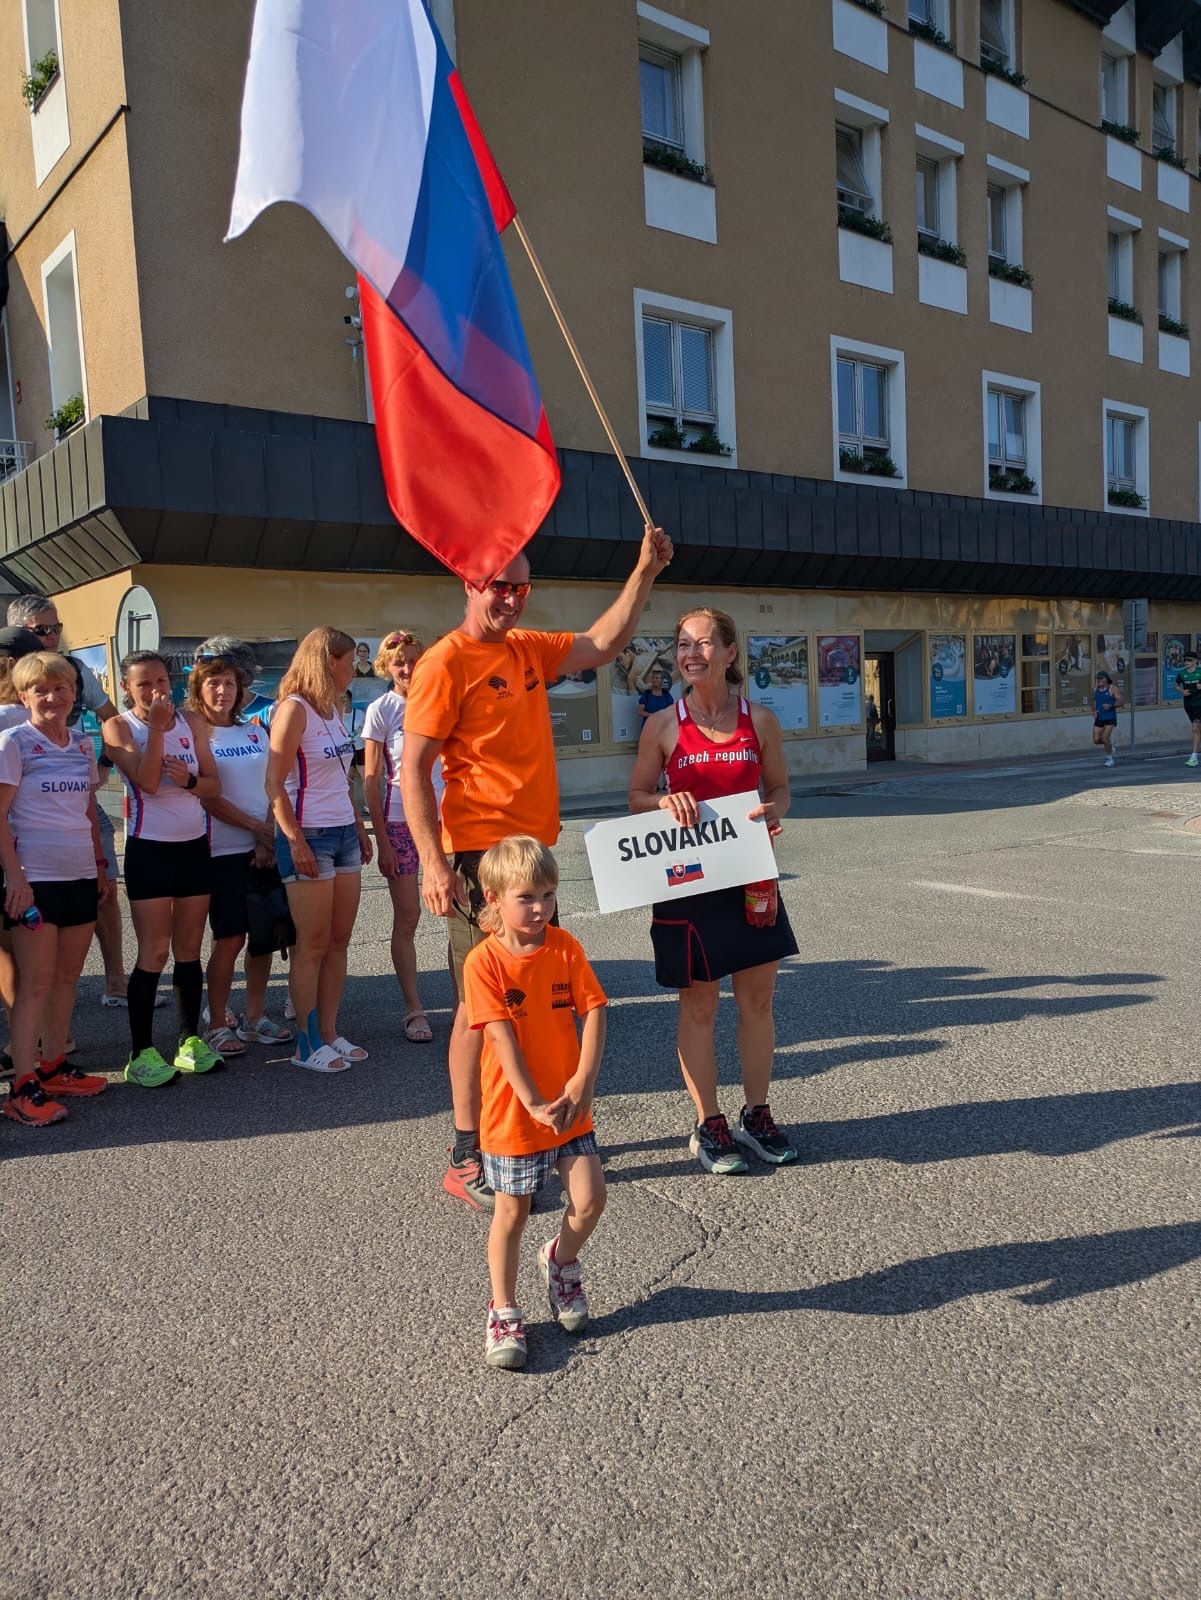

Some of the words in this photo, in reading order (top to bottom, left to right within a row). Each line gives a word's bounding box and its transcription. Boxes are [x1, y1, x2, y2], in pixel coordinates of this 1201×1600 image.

[678, 750, 709, 769] czech
[715, 748, 758, 765] republic
[618, 817, 738, 862] SLOVAKIA
